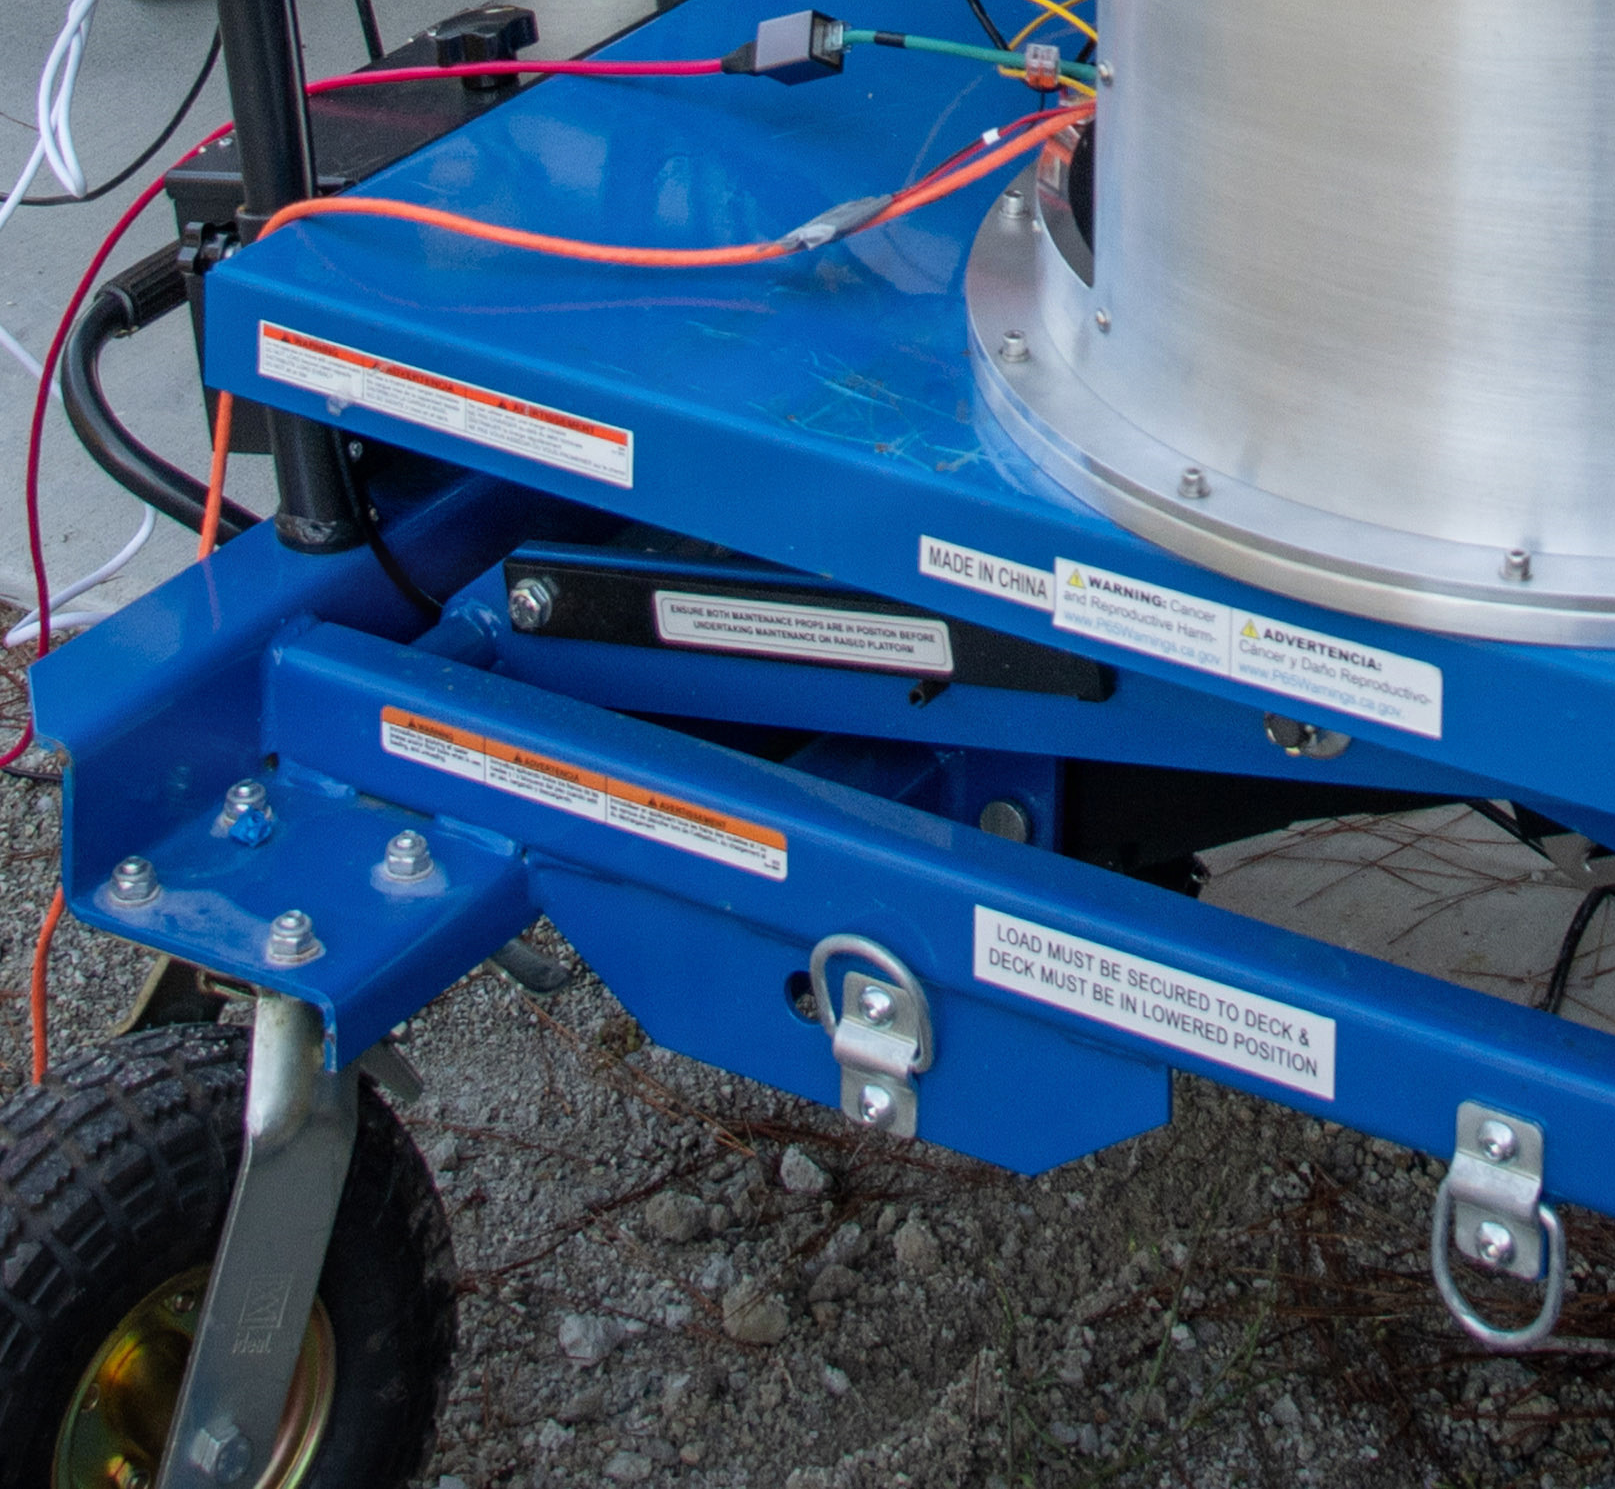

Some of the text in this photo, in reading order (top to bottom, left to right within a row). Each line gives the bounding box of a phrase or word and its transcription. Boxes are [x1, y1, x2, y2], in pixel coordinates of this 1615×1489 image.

[929, 545, 1048, 599] MADE IN CHINA
[1064, 588, 1087, 606] and
[1091, 595, 1173, 633] Reproductive
[1088, 574, 1217, 623] WARNING: Cancer
[670, 604, 935, 643] ENSURE BOTH MAINTENANCE PROPS ARE IN POSITION BEFORE
[693, 620, 914, 654] UNDERTAKING MAINTENANCE ON RAISED PLATFORM
[1264, 628, 1383, 671] ADVERTENCIA:
[1289, 655, 1298, 668] y
[1301, 658, 1337, 678] Daño
[996, 923, 1310, 1048] LOAD MUST BE SECURED TO DECK &
[988, 947, 1318, 1078] DECK MUST BE IN LOWERED POSITION
